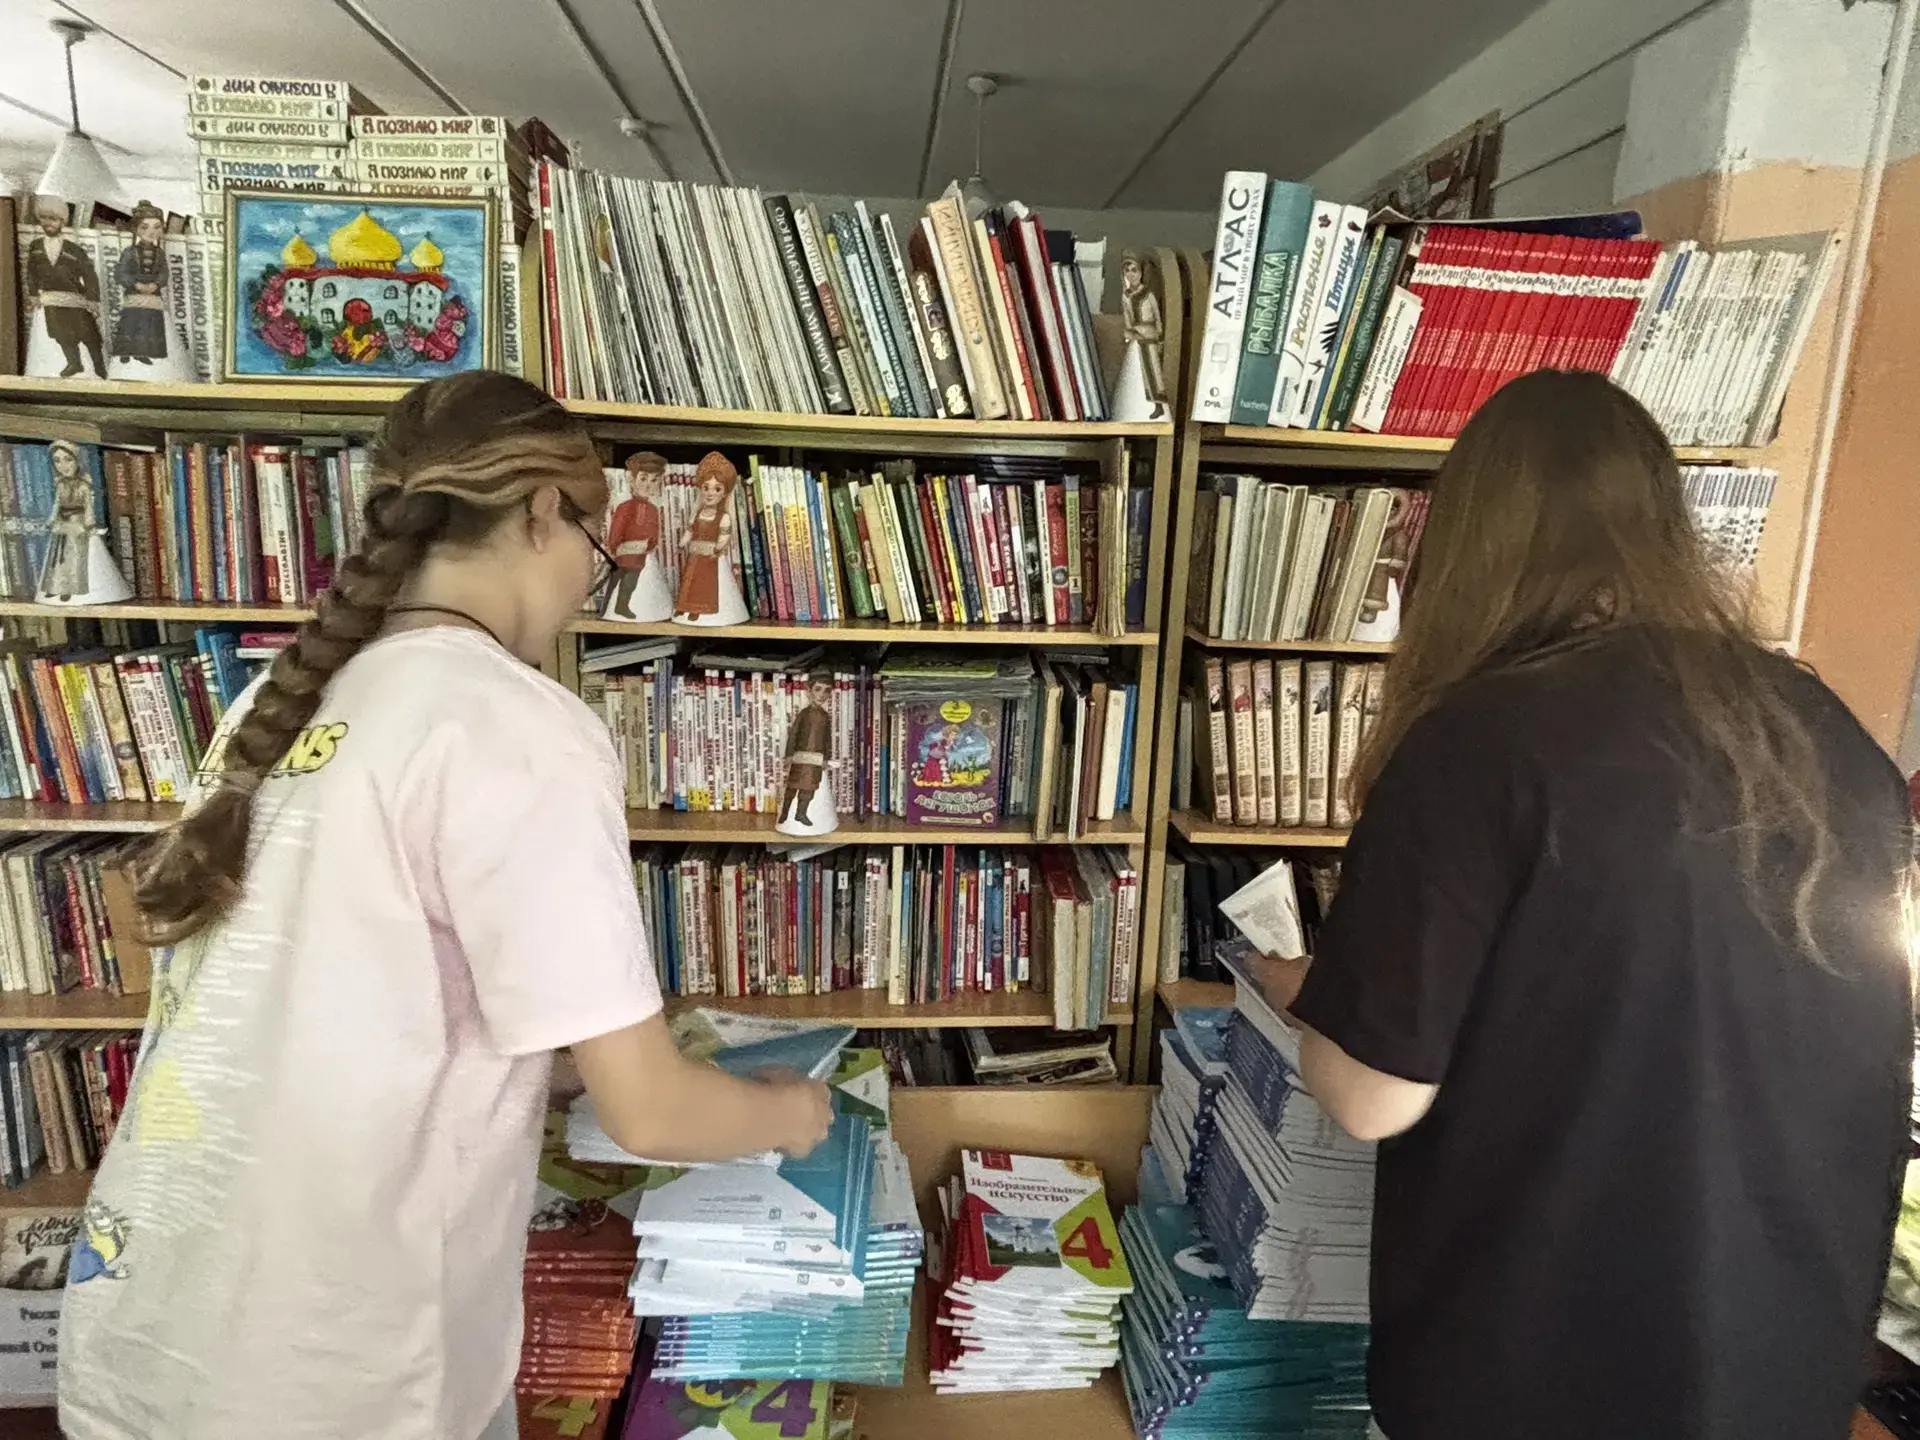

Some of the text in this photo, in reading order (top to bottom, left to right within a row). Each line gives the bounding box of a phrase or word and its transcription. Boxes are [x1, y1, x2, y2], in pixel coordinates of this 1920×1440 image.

[223, 79, 336, 98] Я ПОЗНАЮ МИР
[225, 121, 329, 137] Я ПОЗНАЮ МИР
[362, 117, 473, 134] Я ПОЗНАЮ МИР
[206, 158, 321, 177] Я ПОЗНАЮ МИР
[208, 175, 325, 191] Я ПОЗНАЮ МИР
[368, 165, 468, 180] Я ПОЗНАЮ МИР
[1249, 187, 1262, 220] РУКАХ
[801, 226, 825, 282] ХОЧЕШЬ
[1213, 187, 1250, 318] АТЛАС
[1245, 221, 1256, 253] ТВОИХ
[170, 254, 183, 264] Я
[503, 260, 516, 271] Я
[775, 207, 813, 308] НЕПОЗНАННОГО
[1238, 262, 1249, 285] МИР
[1287, 254, 1299, 295] РЫБОЛОВА
[1325, 237, 1356, 313] Птицы
[171, 266, 187, 318] ПОЗНАЮ
[503, 272, 519, 332] ПОЗНАЮ
[1234, 286, 1245, 319] ЦЕЛЫЙ
[1248, 252, 1288, 354] РЫБАЛКА
[1290, 236, 1325, 349] Растения
[821, 292, 841, 332] ЗНАТЬ
[1403, 324, 1415, 347] Кто
[1384, 345, 1398, 384] такое?
[1389, 349, 1406, 387] такой?
[277, 529, 291, 596] ХРЕСТОМАТИЯ
[1211, 716, 1220, 767] ШКОЛЬНАЯ
[1236, 714, 1246, 771] ШКОЛЬНАЯ
[1258, 718, 1266, 768] ШКОЛЬНАЯ
[971, 1177, 1087, 1195] Изобразительное
[989, 1190, 1070, 1203] искусство
[1061, 1216, 1112, 1269] 4
[531, 1395, 597, 1437] 4
[750, 1379, 817, 1437] 4
